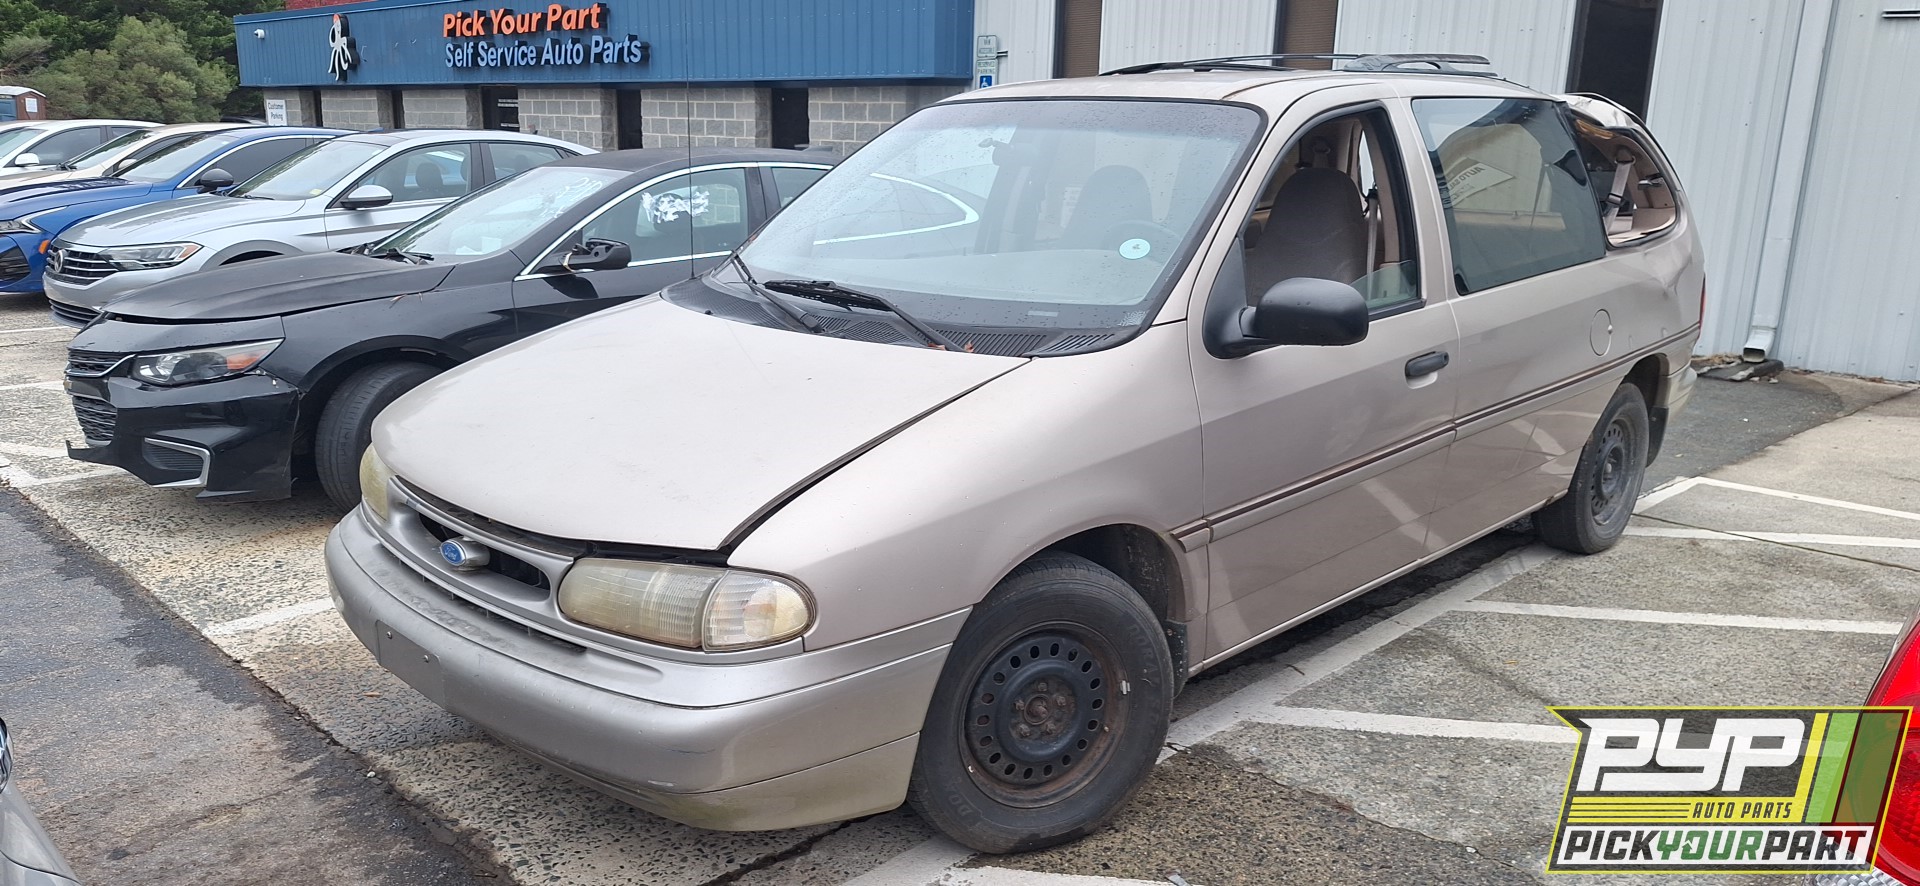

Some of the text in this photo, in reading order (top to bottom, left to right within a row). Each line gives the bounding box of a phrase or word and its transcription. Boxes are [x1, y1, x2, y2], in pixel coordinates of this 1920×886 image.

[443, 3, 601, 37] Pick Your Part
[445, 35, 642, 67] Self Service Auto Parts
